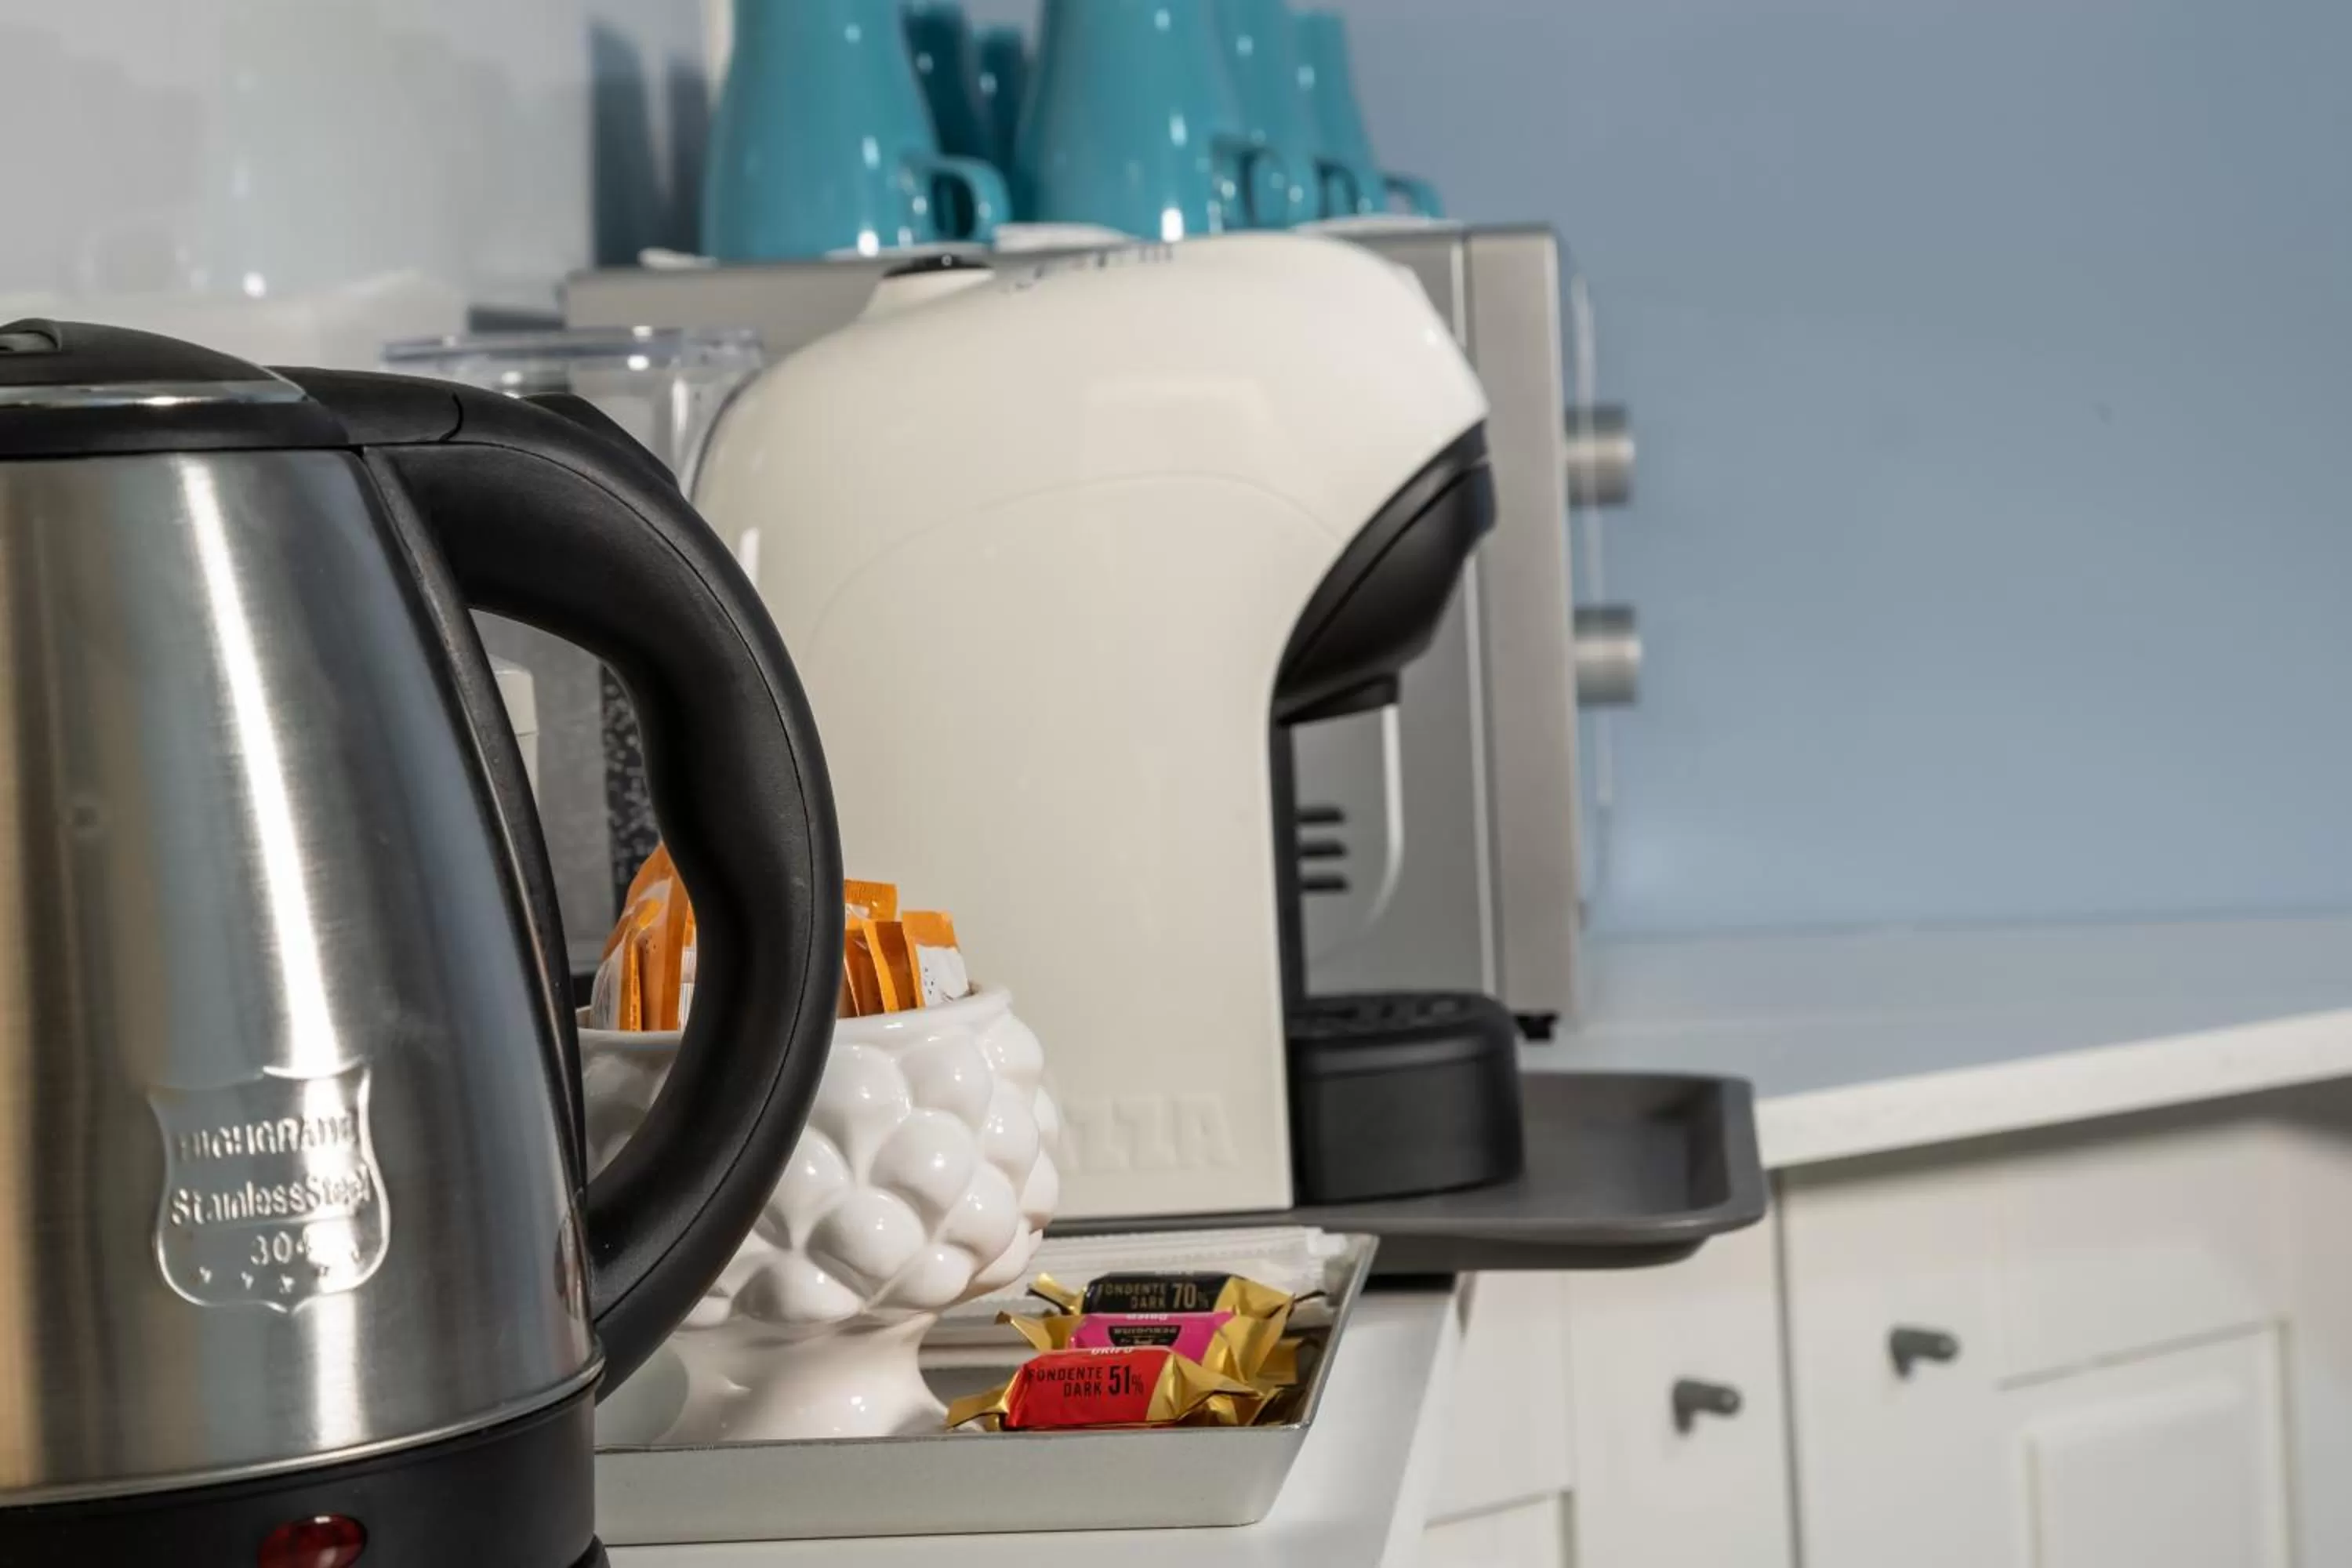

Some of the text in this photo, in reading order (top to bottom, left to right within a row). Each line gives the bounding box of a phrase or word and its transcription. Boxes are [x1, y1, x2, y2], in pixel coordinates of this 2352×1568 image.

[1130, 1294, 1167, 1310] DARK
[1025, 1364, 1145, 1396] FONDENTE 51%
[1063, 1380, 1102, 1398] DARK
